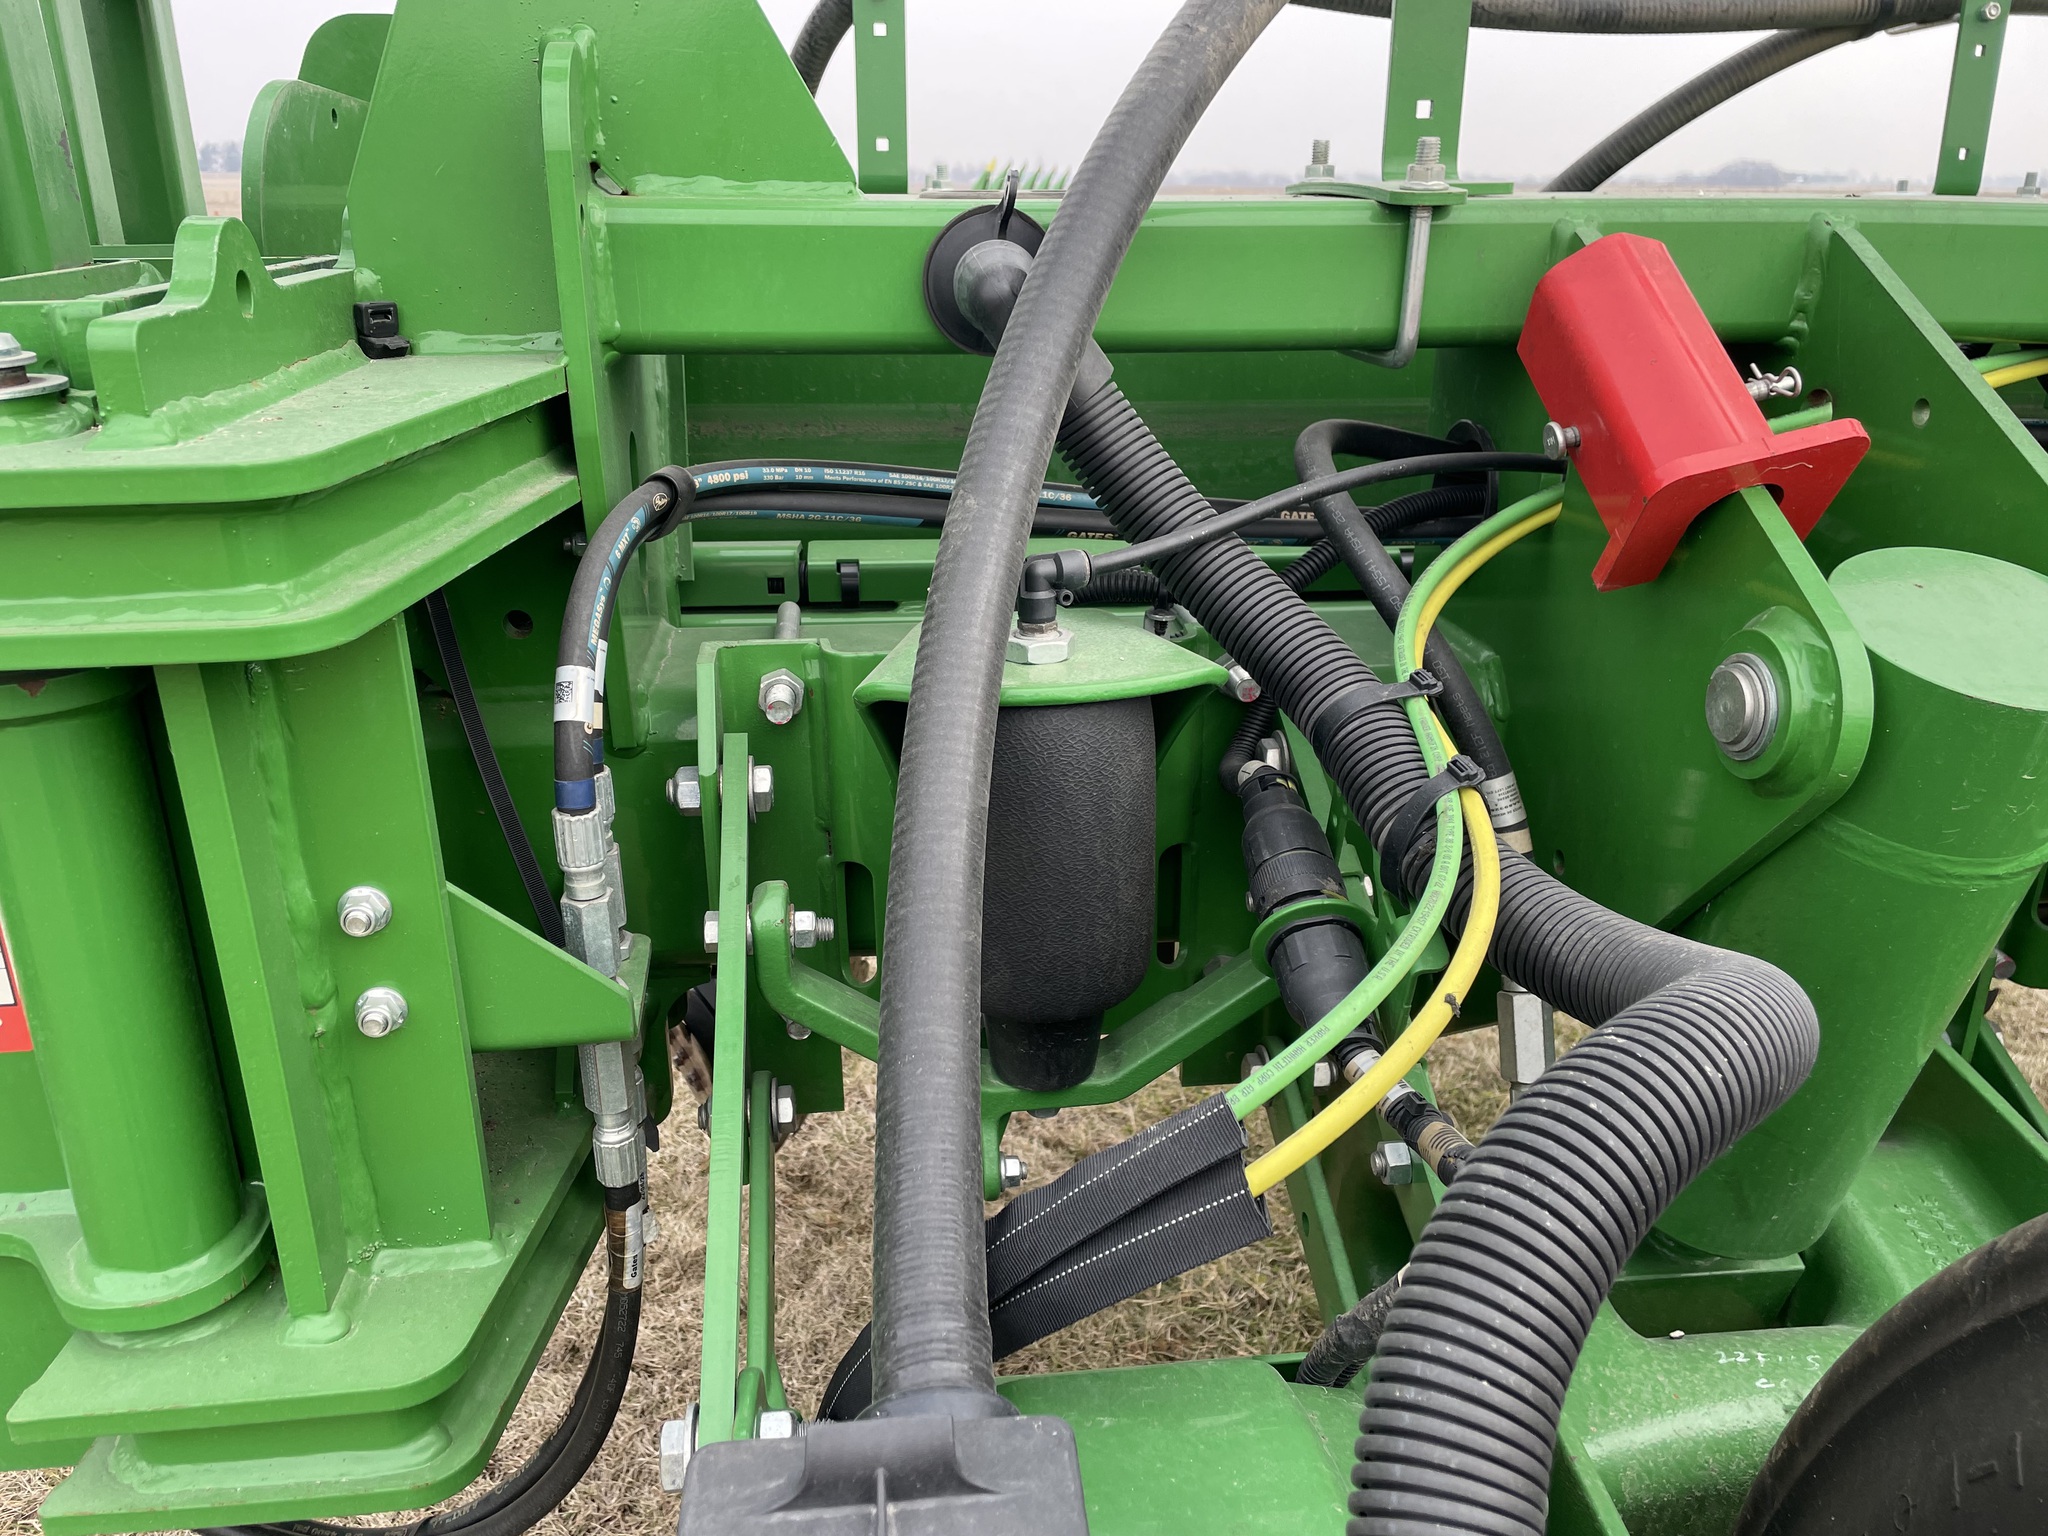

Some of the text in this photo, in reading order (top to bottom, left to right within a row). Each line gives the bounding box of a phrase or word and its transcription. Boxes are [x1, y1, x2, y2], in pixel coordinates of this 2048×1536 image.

[707, 472, 731, 485] 4800
[733, 470, 749, 483] psi
[824, 474, 841, 482] Meets
[843, 475, 877, 484] Performance
[924, 482, 934, 490] SAE
[777, 513, 805, 521] MSHA
[1280, 510, 1316, 520] GATE
[1343, 526, 1366, 556] MSHA
[1432, 660, 1451, 682] ISO
[1452, 692, 1475, 728] Meets
[1470, 732, 1490, 758] 212F
[1385, 952, 1400, 968] THE
[1307, 1024, 1331, 1047] PARKER
[1274, 1043, 1306, 1072] HANNIFIN
[630, 1253, 639, 1279] Gates
